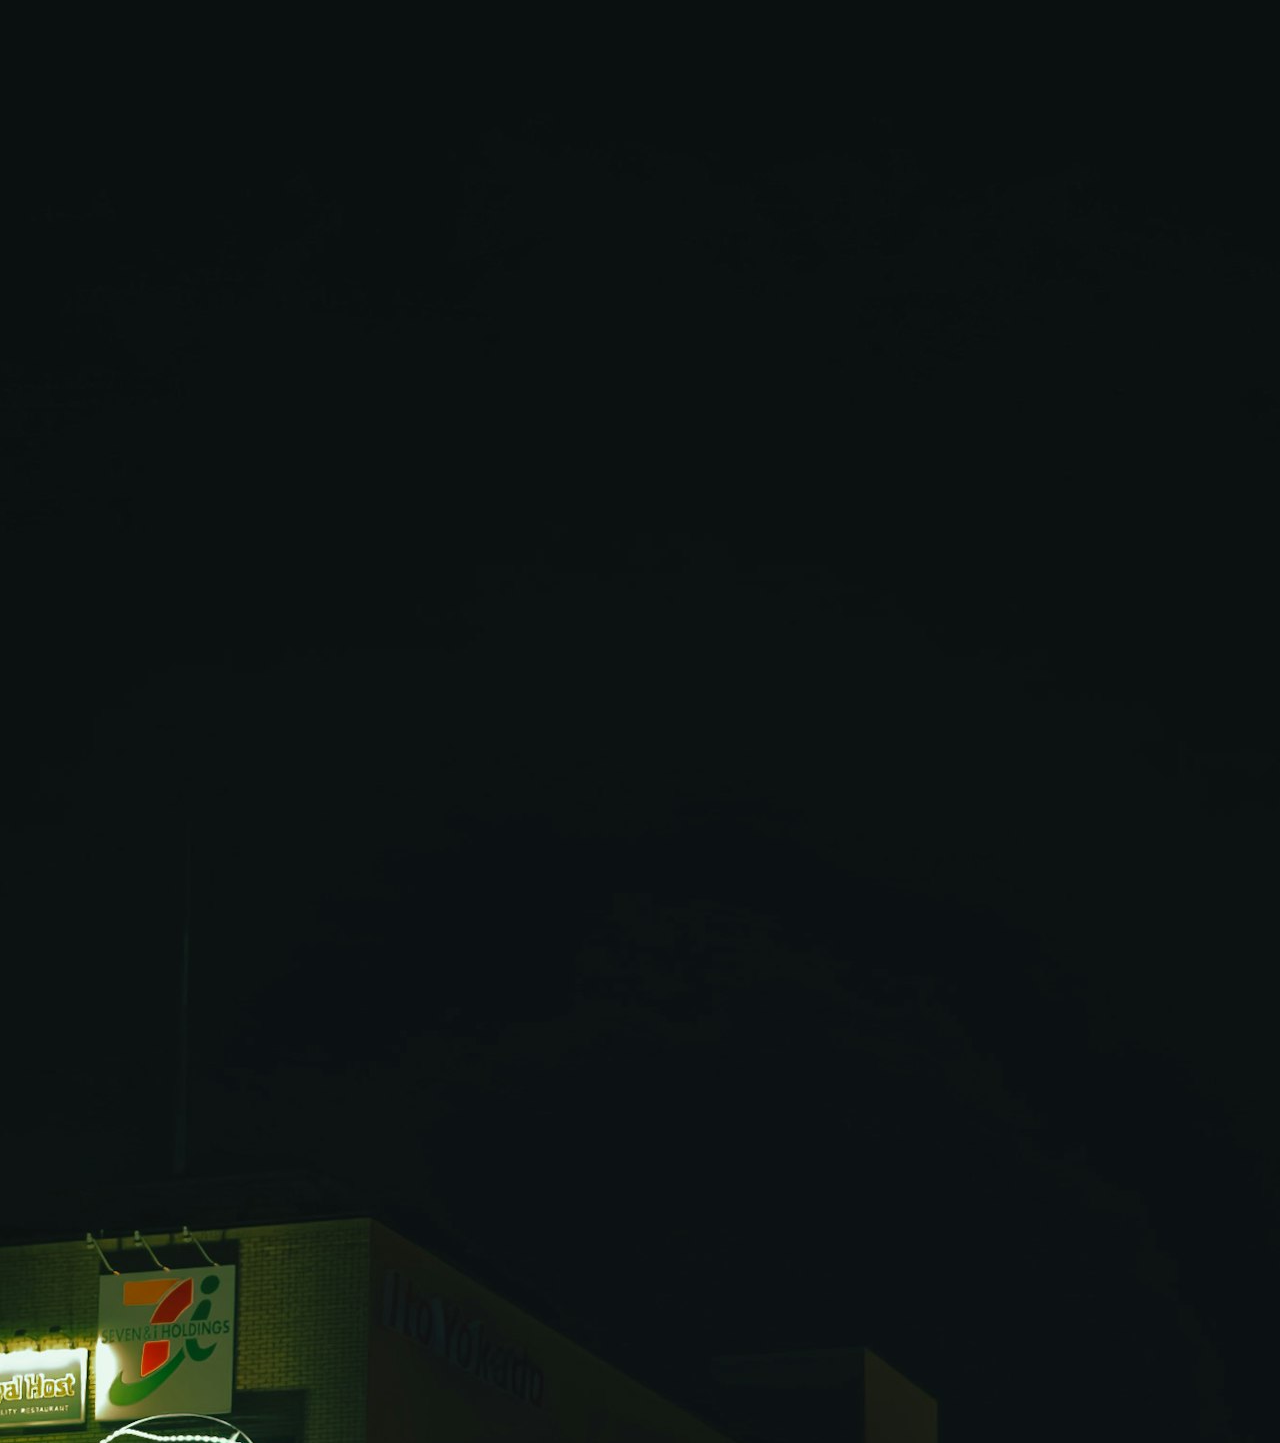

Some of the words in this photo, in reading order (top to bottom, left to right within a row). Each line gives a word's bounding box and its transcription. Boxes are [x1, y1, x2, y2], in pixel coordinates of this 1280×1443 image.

[101, 1326, 142, 1344] SEVEN
[161, 1320, 231, 1338] HOLDINGS
[24, 1372, 76, 1399] Host
[20, 1404, 70, 1414] RESTAURANT
